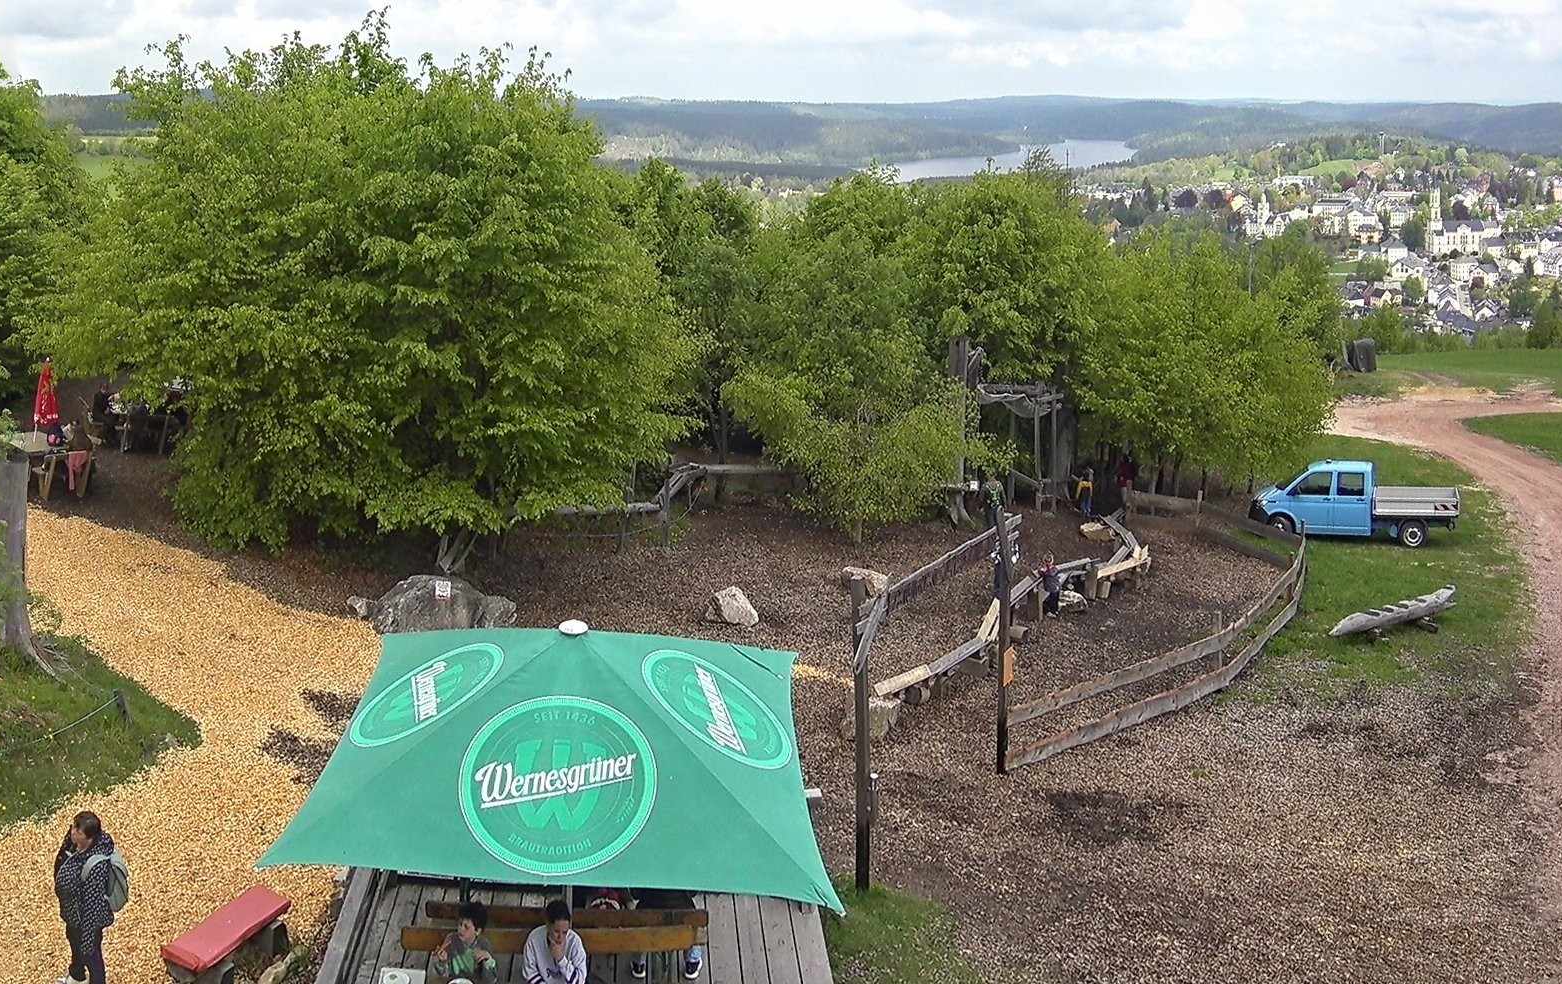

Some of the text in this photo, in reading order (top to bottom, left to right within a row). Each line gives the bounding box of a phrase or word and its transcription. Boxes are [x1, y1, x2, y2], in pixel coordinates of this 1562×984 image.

[534, 710, 596, 726] SEIT 1436
[474, 753, 637, 803] Wernesgrüner
[508, 832, 592, 856] BRAUTRADITION
